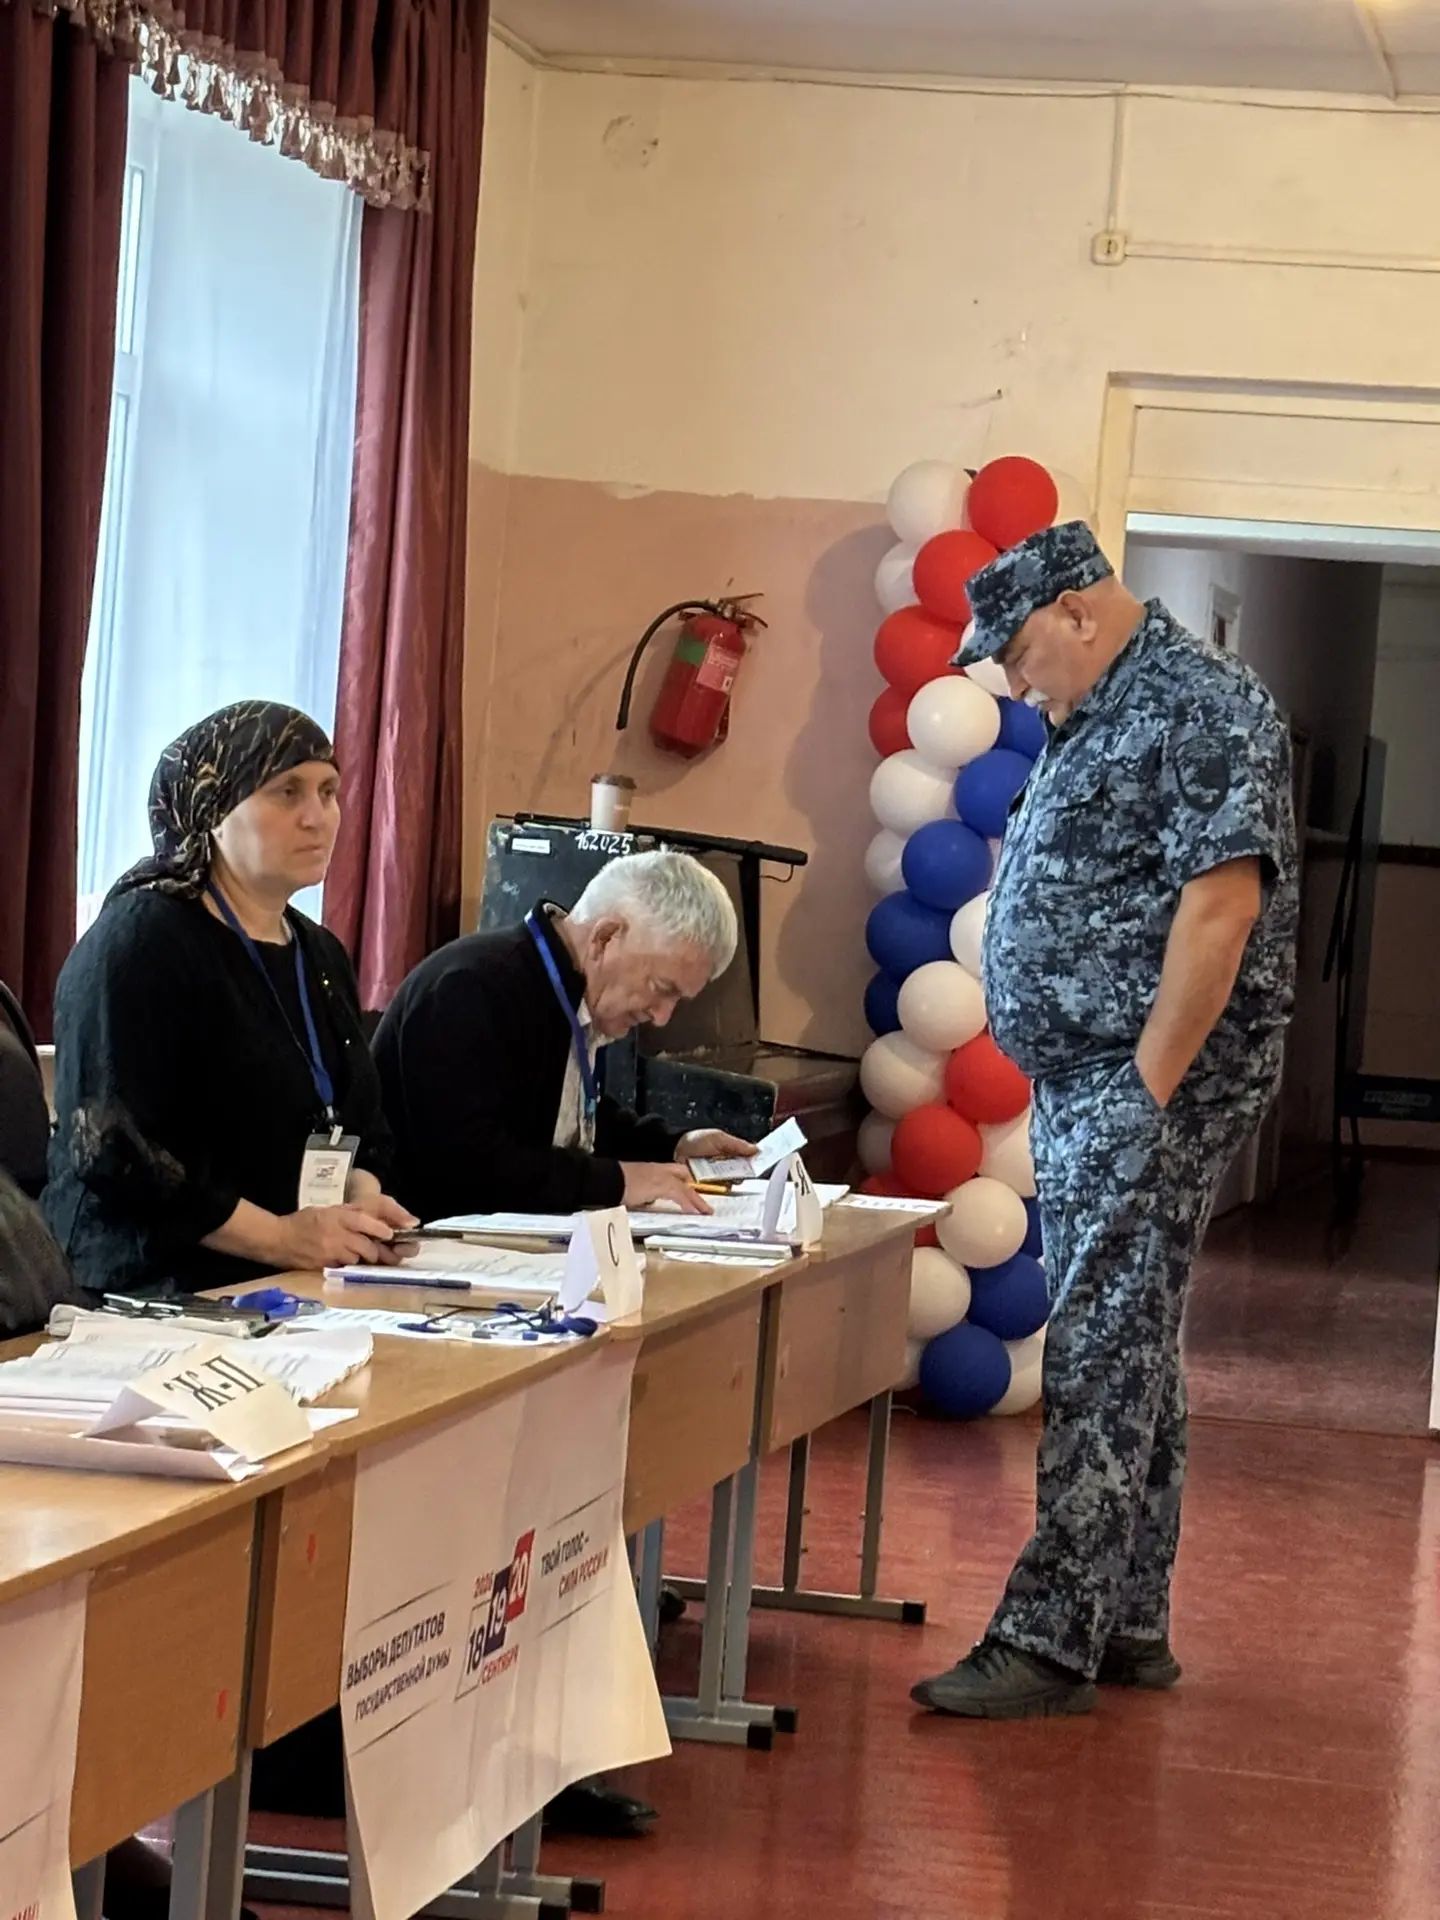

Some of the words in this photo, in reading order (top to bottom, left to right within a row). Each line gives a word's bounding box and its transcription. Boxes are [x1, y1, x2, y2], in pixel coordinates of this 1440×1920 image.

[607, 1222, 620, 1267] С
[163, 1355, 265, 1412] Ж-П
[466, 1625, 485, 1675] 18
[488, 1587, 508, 1638] 19
[509, 1552, 529, 1604] 20
[346, 1642, 389, 1690] ВЫБОРЫ
[388, 1612, 446, 1668] ДЕПУТАТОВ
[355, 1655, 426, 1721] ГОСУДАРСТВЕННОЙ
[425, 1647, 452, 1680] ДУМЫ
